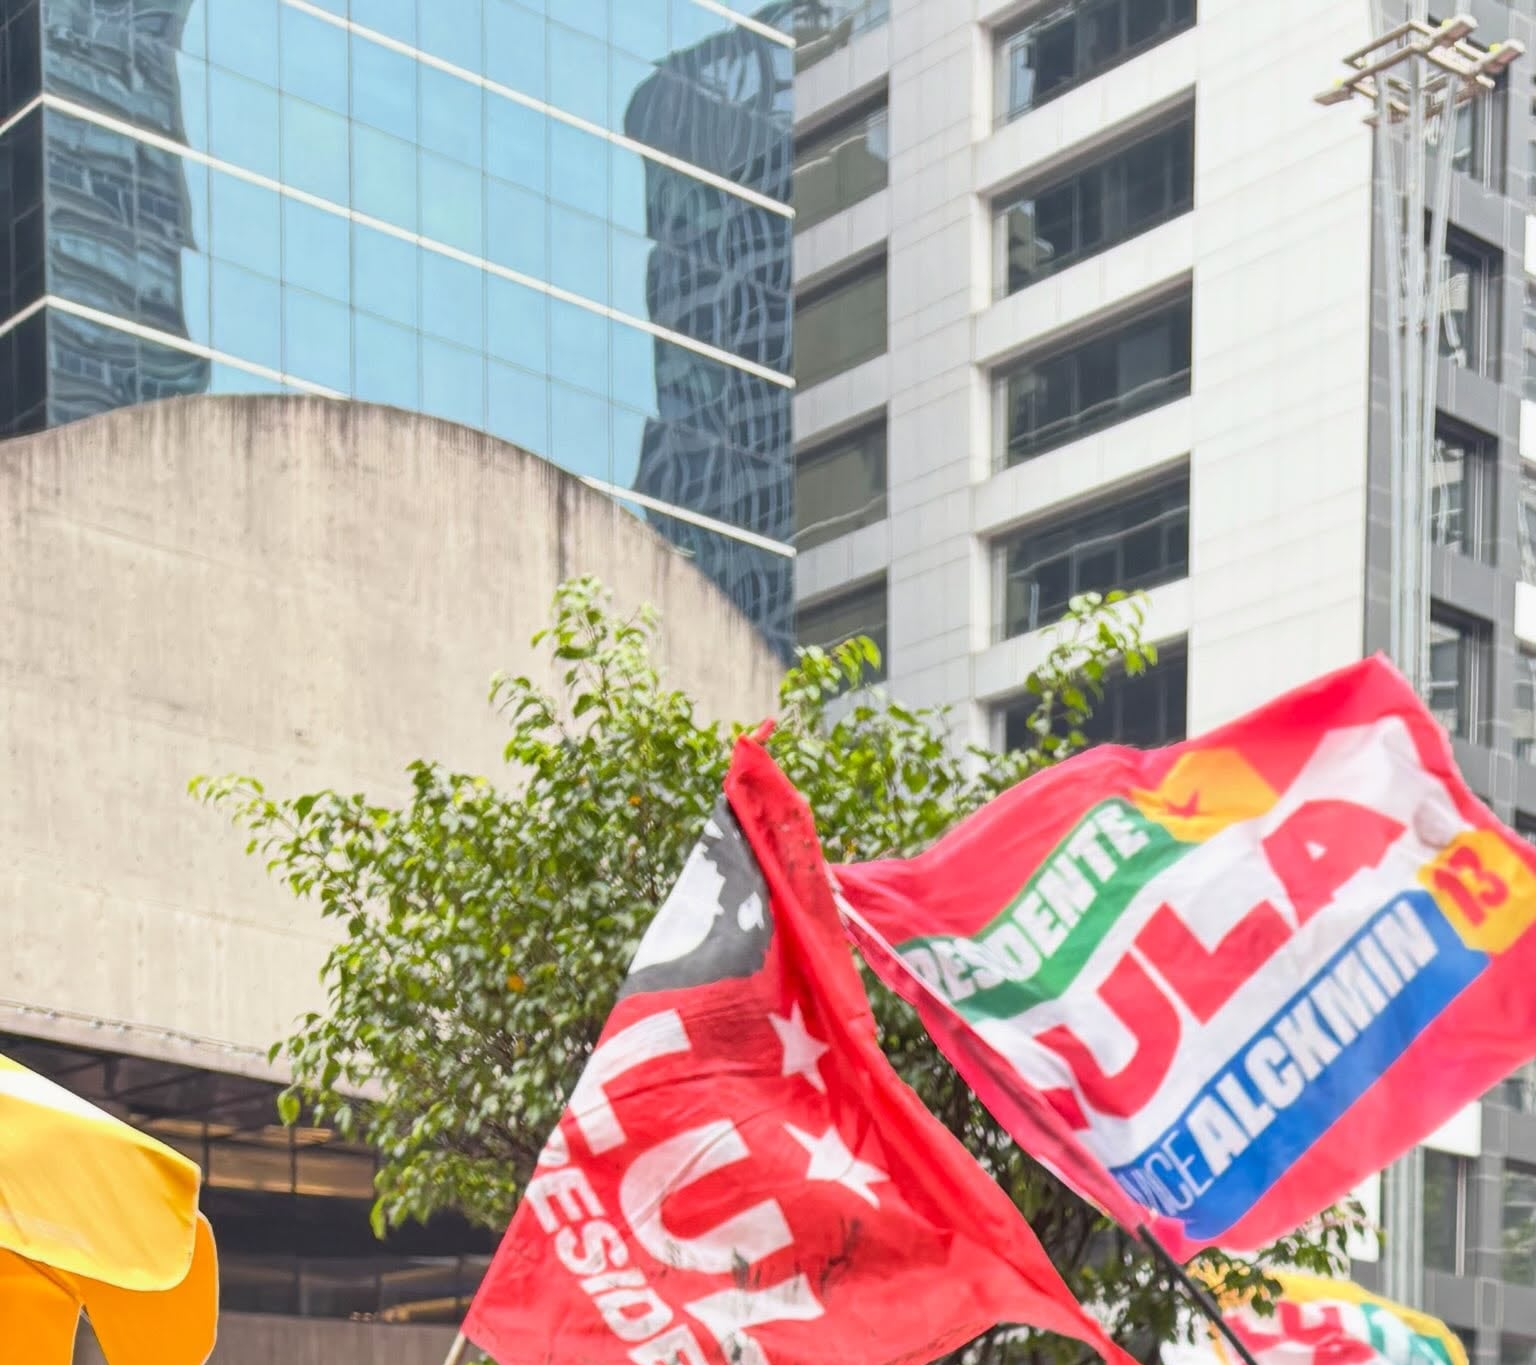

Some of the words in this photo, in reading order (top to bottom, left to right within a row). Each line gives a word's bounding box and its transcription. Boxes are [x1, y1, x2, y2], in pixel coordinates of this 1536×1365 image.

[1033, 799, 1407, 1131] ULA
[1431, 845, 1511, 928] 13
[1186, 901, 1439, 1168] ALCKMIN
